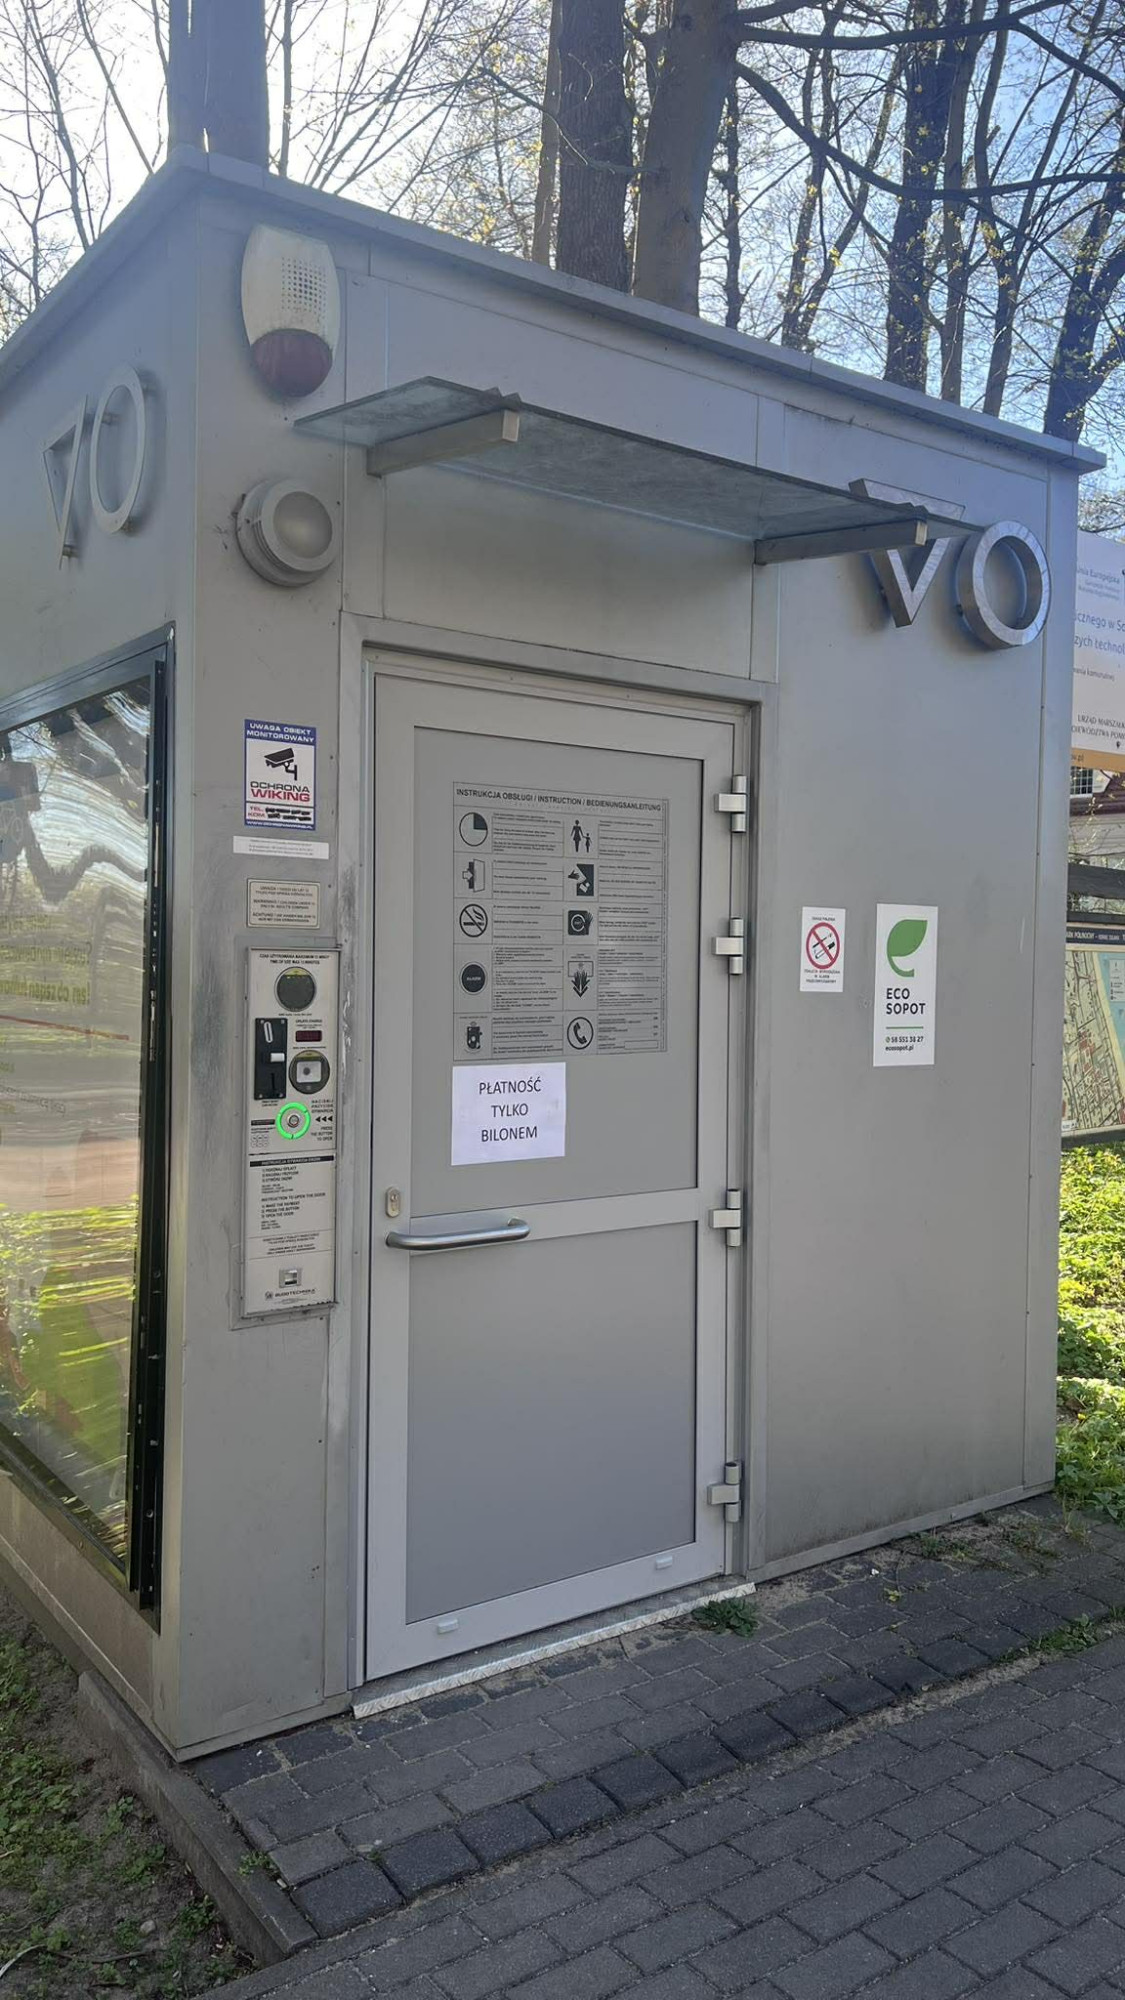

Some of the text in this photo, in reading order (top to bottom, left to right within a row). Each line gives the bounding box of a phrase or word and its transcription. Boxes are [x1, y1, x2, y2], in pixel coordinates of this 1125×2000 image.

[1075, 613, 1106, 629] cznego
[1108, 620, 1115, 629] w
[1077, 714, 1097, 725] URZĄD
[249, 723, 312, 736] UWAGA OBIEKT
[246, 730, 315, 743] MONITOROWANY
[250, 781, 310, 793] OCHRONA
[250, 788, 311, 802] WIKING
[456, 788, 502, 799] INSTRUKCJA
[502, 792, 534, 801] OBSŁUGI
[537, 795, 582, 805] INSTRUCTION
[586, 799, 662, 811] BEDIENUNGSANLEITUNG
[886, 988, 910, 1000] ECO
[886, 1002, 926, 1015] SOPOT
[479, 1076, 542, 1095] PŁATNOŚĆ
[491, 1103, 529, 1118] TYLKO
[481, 1126, 538, 1142] BILONEM
